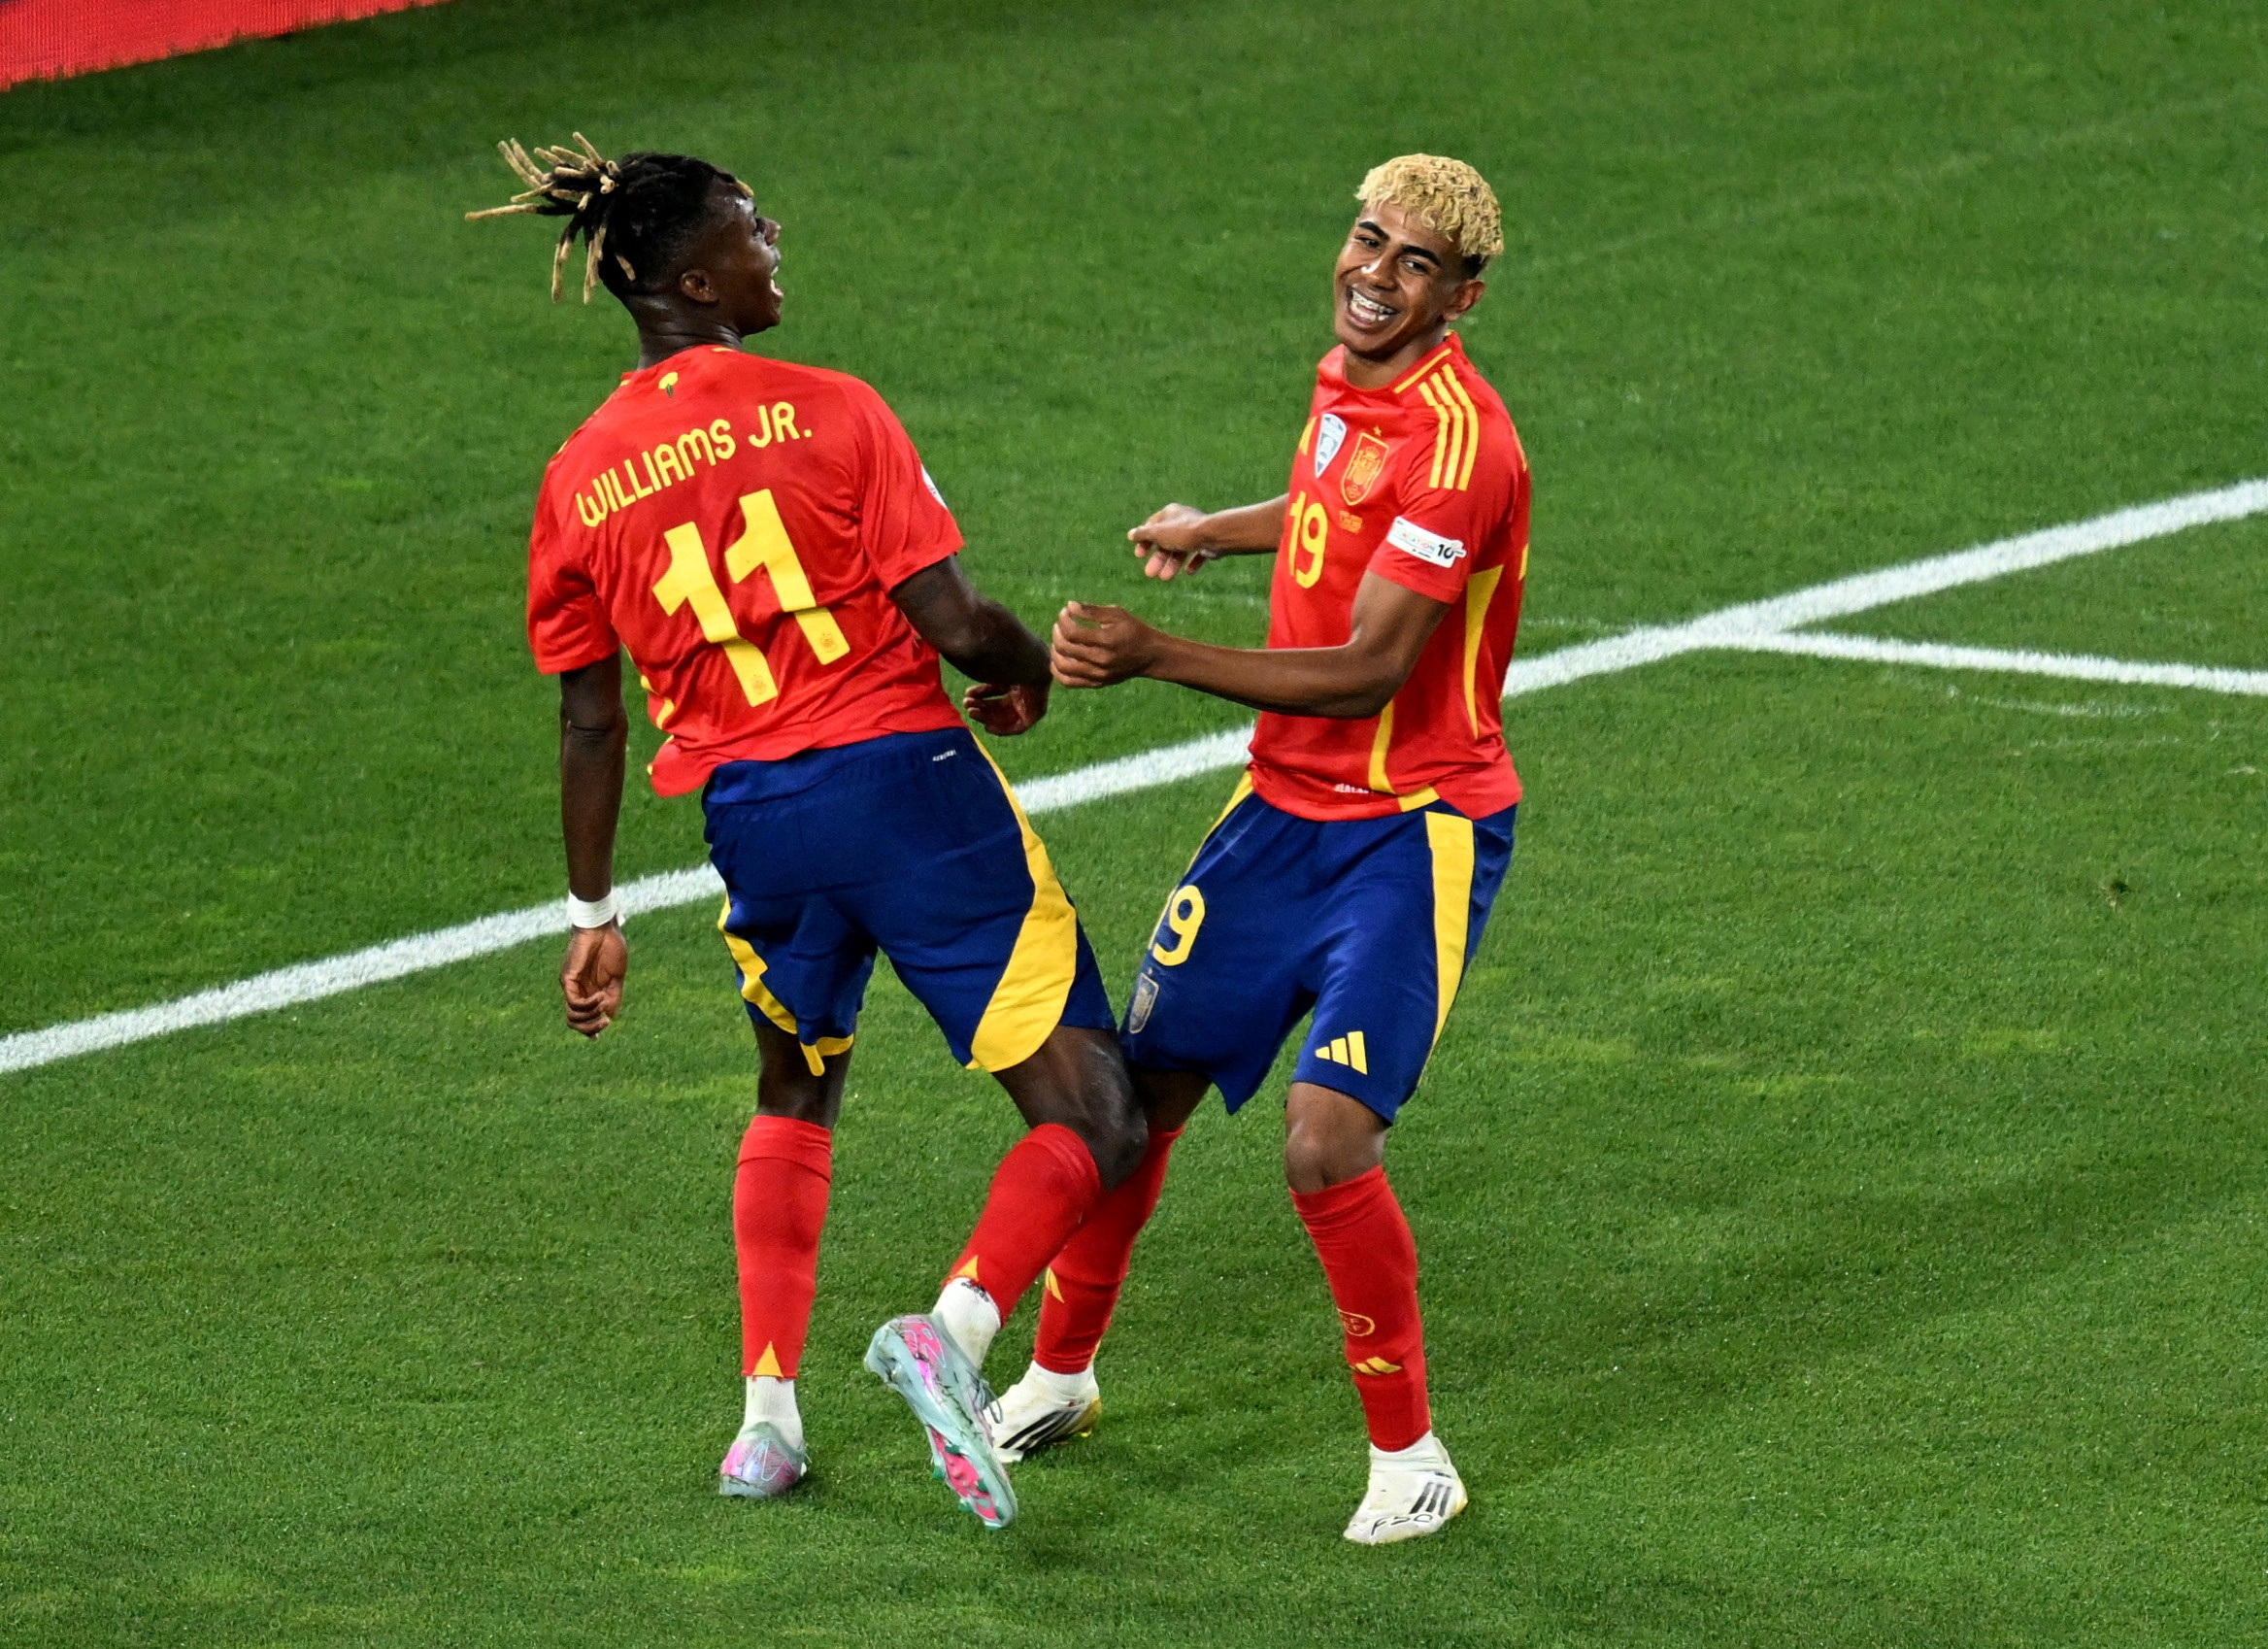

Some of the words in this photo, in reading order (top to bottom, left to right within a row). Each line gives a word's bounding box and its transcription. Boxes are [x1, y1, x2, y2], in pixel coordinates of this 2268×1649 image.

[575, 419, 736, 527] WILLIAMS
[748, 401, 813, 448] JR.
[1288, 490, 1328, 589] 19
[651, 488, 850, 708] 11
[1149, 885, 1206, 966] 9
